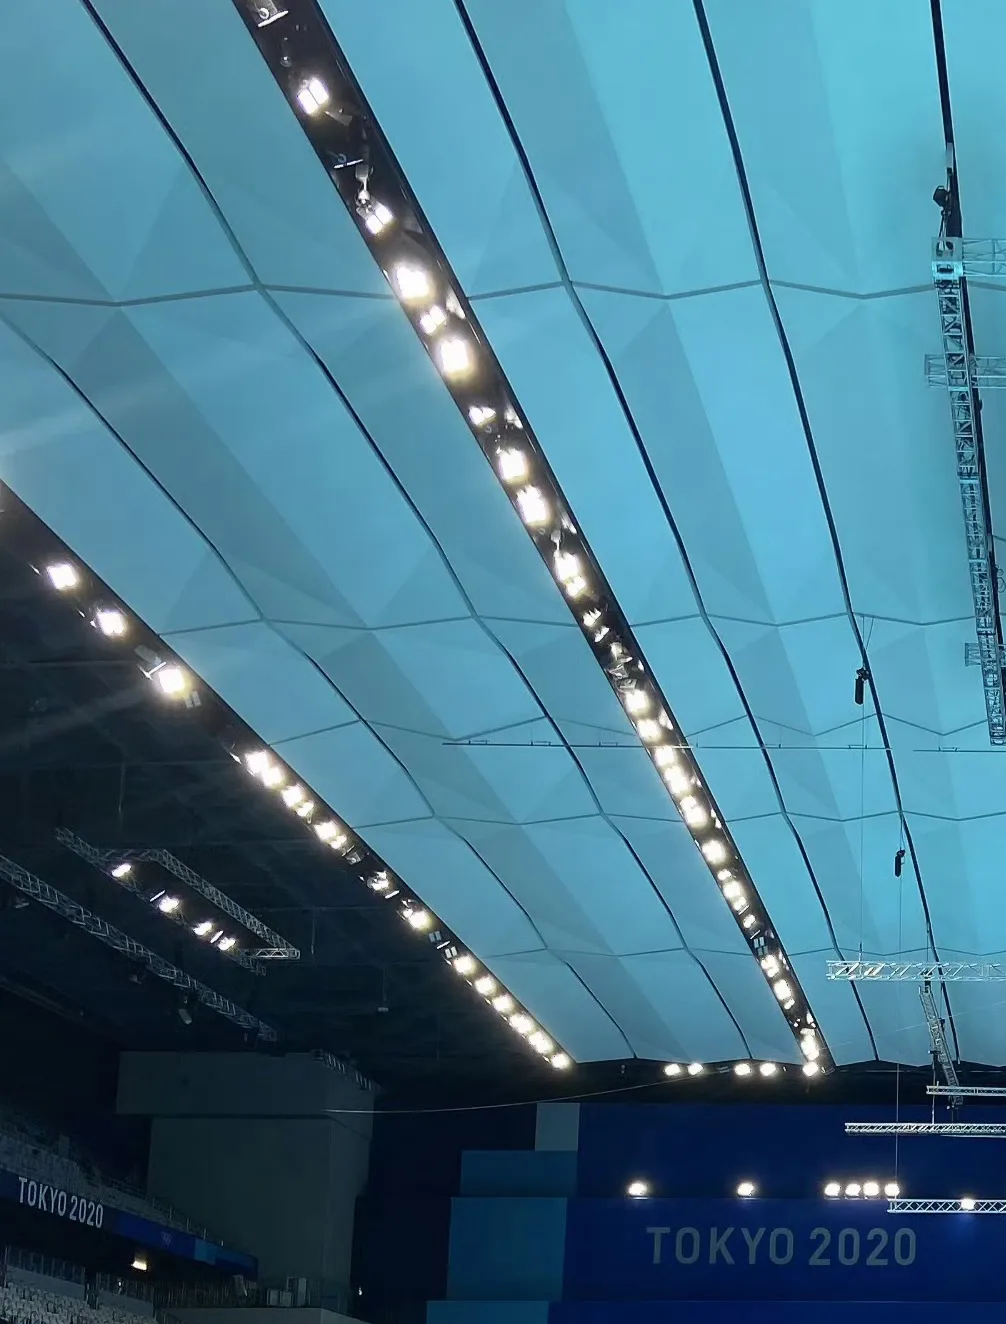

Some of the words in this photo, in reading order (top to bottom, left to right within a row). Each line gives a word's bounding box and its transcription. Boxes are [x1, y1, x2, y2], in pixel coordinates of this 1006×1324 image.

[19, 1176, 67, 1216] TOKYO
[69, 1195, 104, 1228] 2020
[646, 1227, 794, 1264] TOKYO
[808, 1227, 917, 1266] 2020
